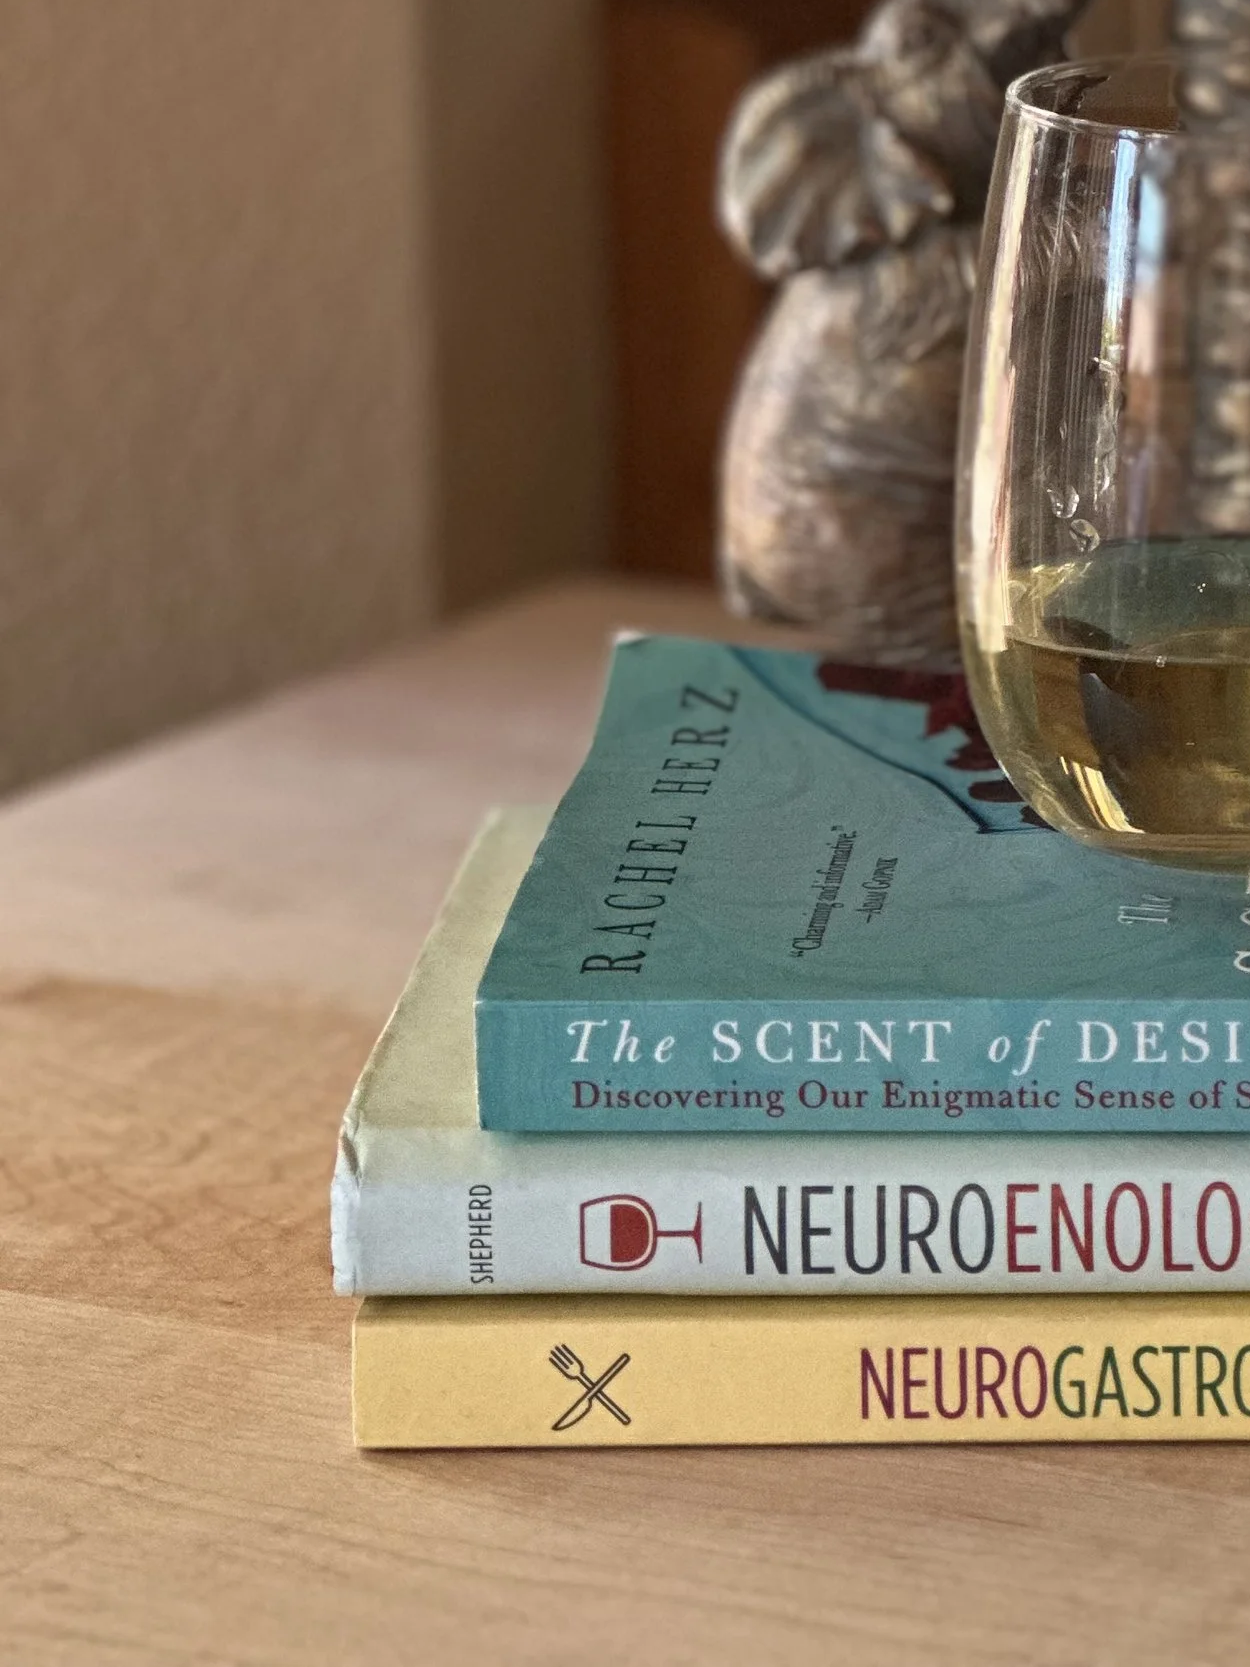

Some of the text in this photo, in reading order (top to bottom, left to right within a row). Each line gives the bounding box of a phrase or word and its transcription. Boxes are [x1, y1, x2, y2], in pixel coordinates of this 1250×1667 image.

[579, 683, 741, 975] RACHEL HERZ
[810, 884, 841, 902] and
[1117, 893, 1174, 925] The
[566, 1018, 676, 1064] The
[711, 1019, 953, 1064] SCENT
[987, 1018, 1052, 1077] of
[571, 1079, 785, 1118] Discovering
[797, 1079, 869, 1109] Our
[881, 1079, 1061, 1118] Enigmatic
[1074, 1079, 1176, 1110] Sense
[1188, 1079, 1227, 1110] of
[468, 1184, 494, 1284] SHEPHERD
